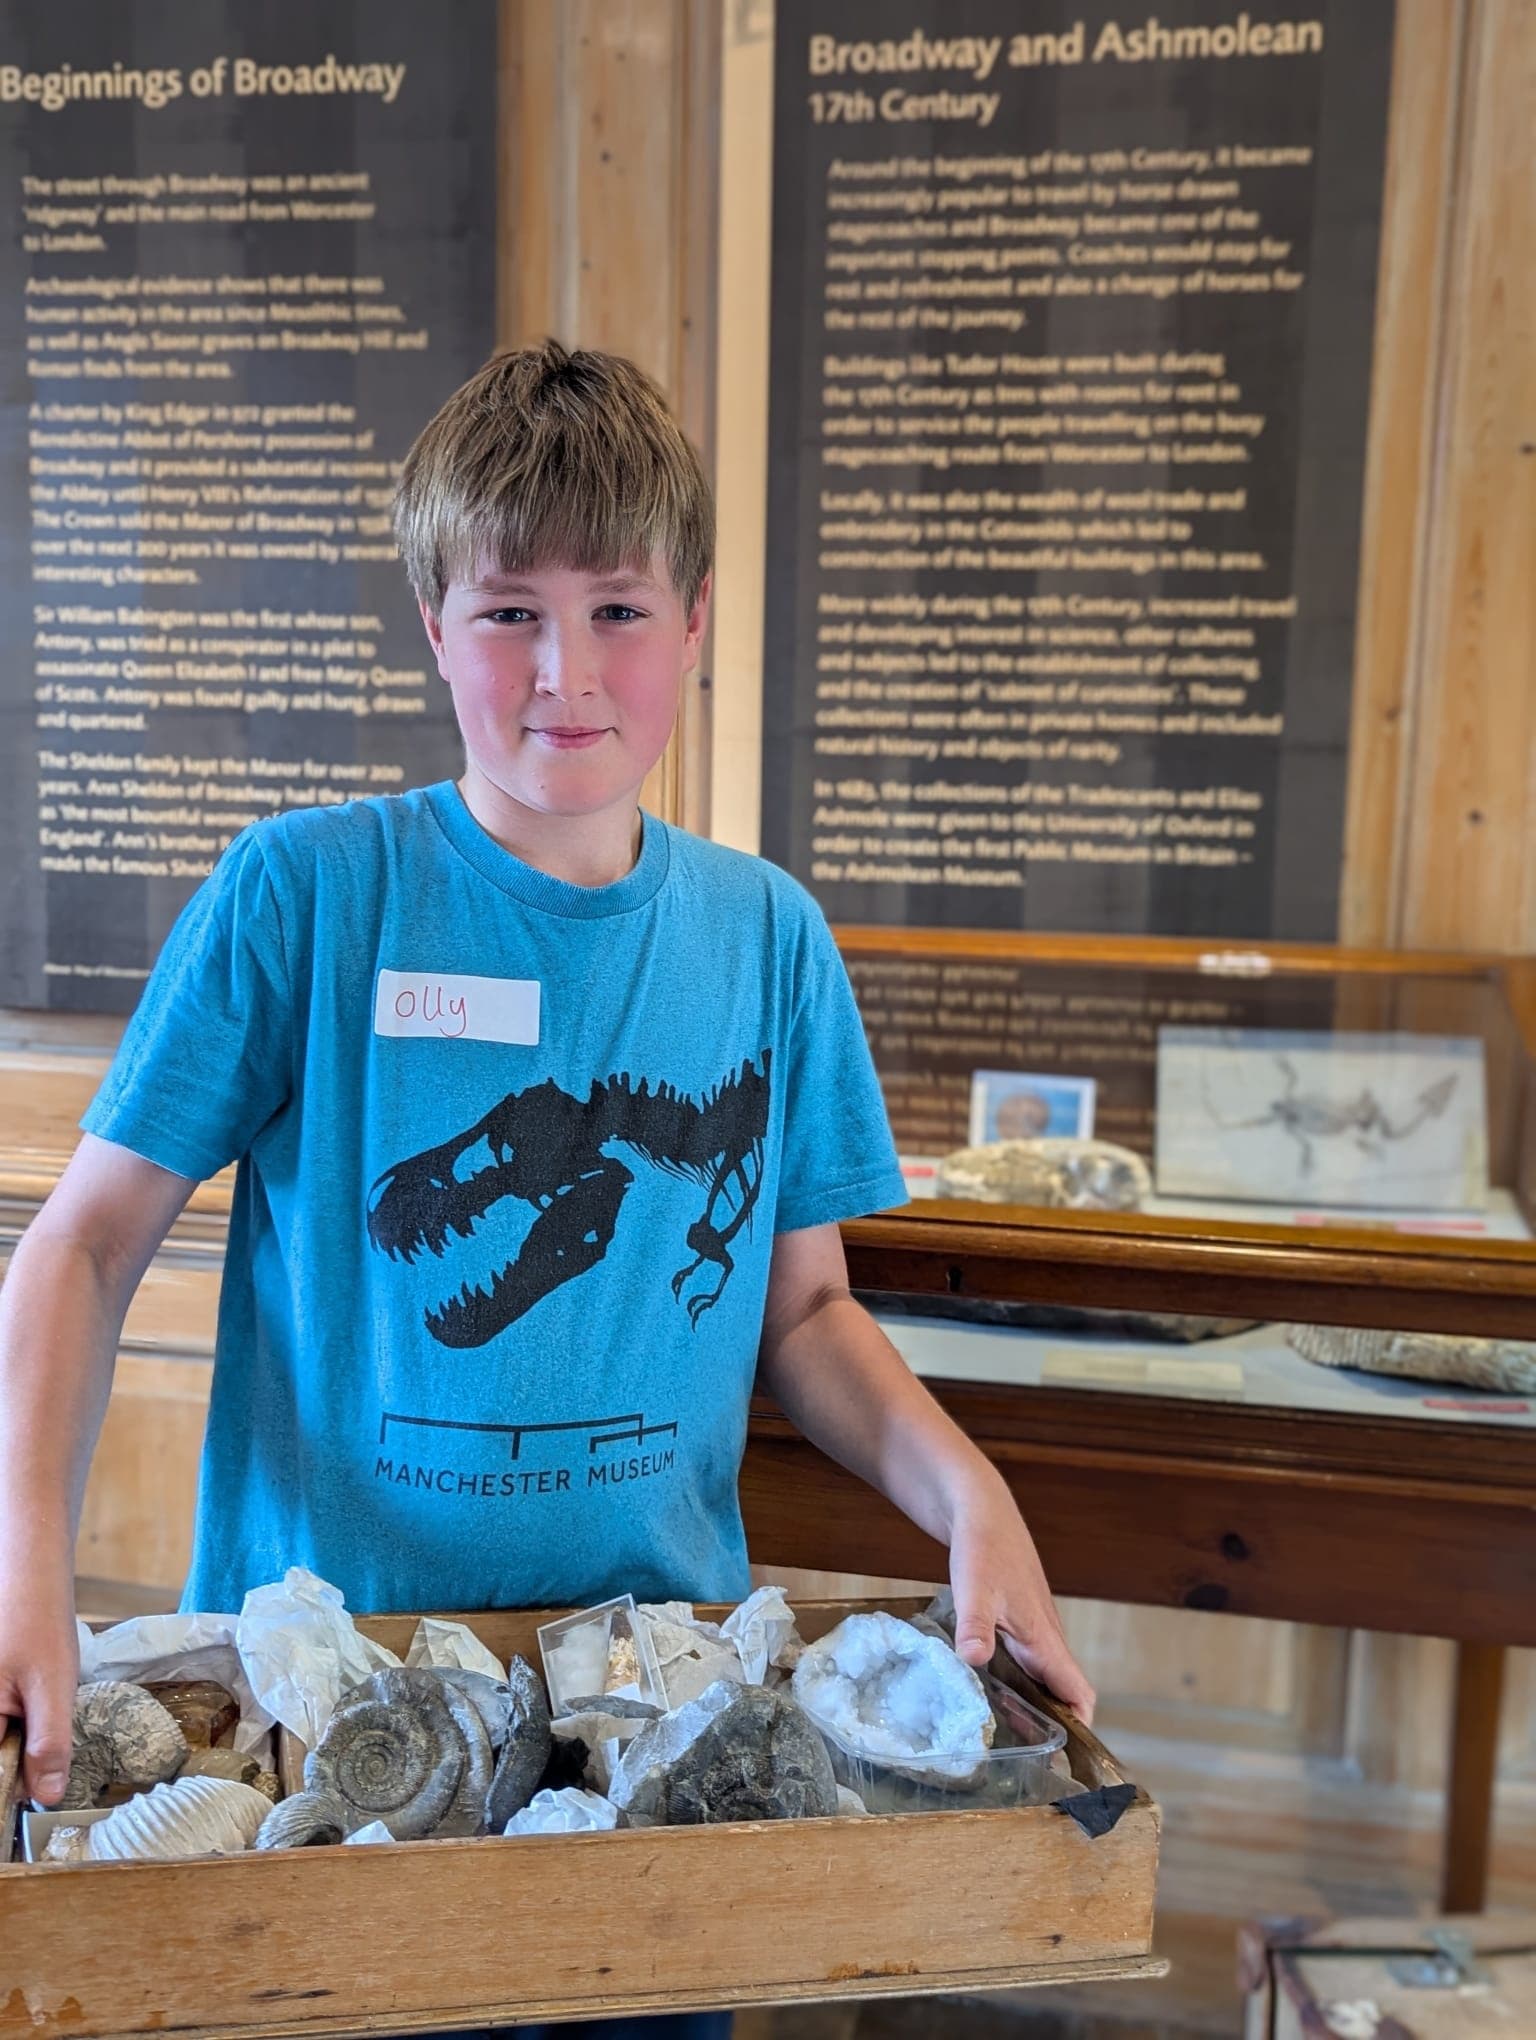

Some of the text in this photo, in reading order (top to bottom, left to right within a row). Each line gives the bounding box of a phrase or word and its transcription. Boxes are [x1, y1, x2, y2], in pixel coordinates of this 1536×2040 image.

[808, 14, 1323, 80] Broadway and Ashmolean
[0, 55, 406, 112] Beginnings of Broadway
[808, 89, 1000, 126] 17th Century
[395, 985, 467, 1037] Olly
[375, 1450, 675, 1497] MANCHESTER MUSEUM
